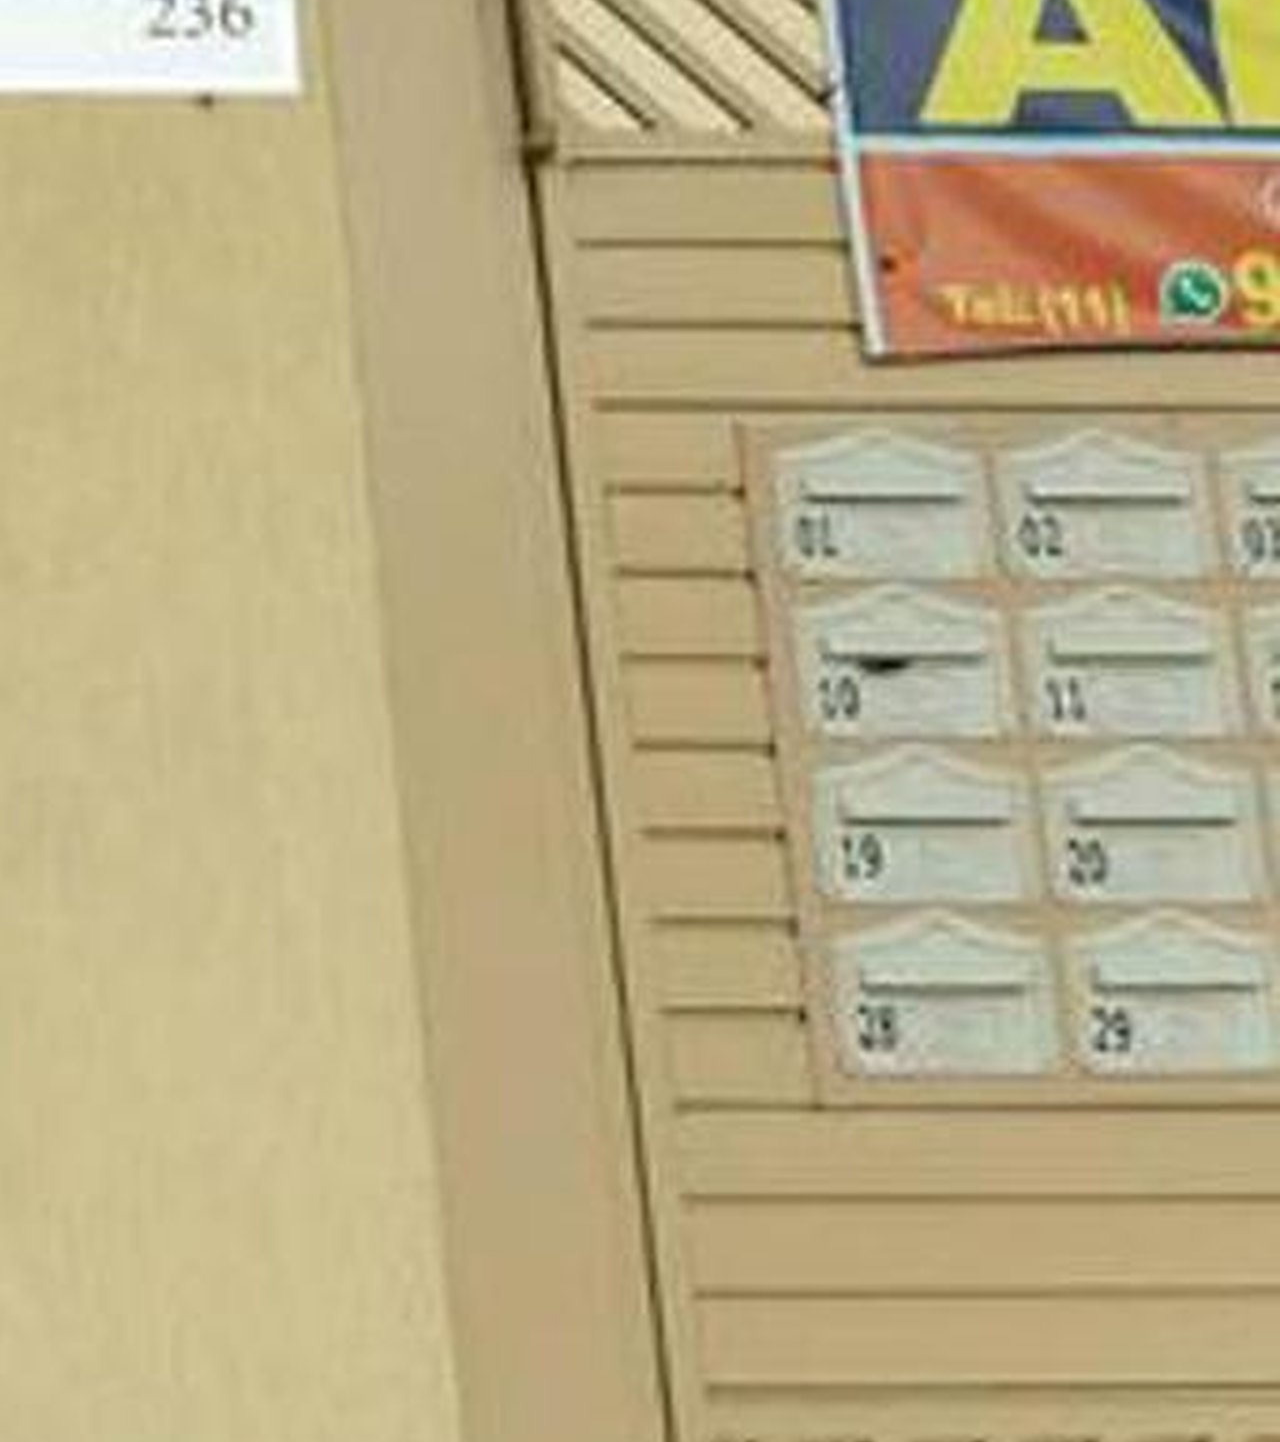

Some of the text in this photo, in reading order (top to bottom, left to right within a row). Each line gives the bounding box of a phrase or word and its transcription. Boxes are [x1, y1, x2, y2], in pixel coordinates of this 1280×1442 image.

[796, 515, 838, 558] 01
[1016, 515, 1063, 558] 02
[818, 676, 861, 720] 10
[1045, 677, 1086, 721] 11
[842, 833, 883, 880] 19
[1067, 838, 1108, 885] 20
[1091, 1006, 1131, 1053] 29
